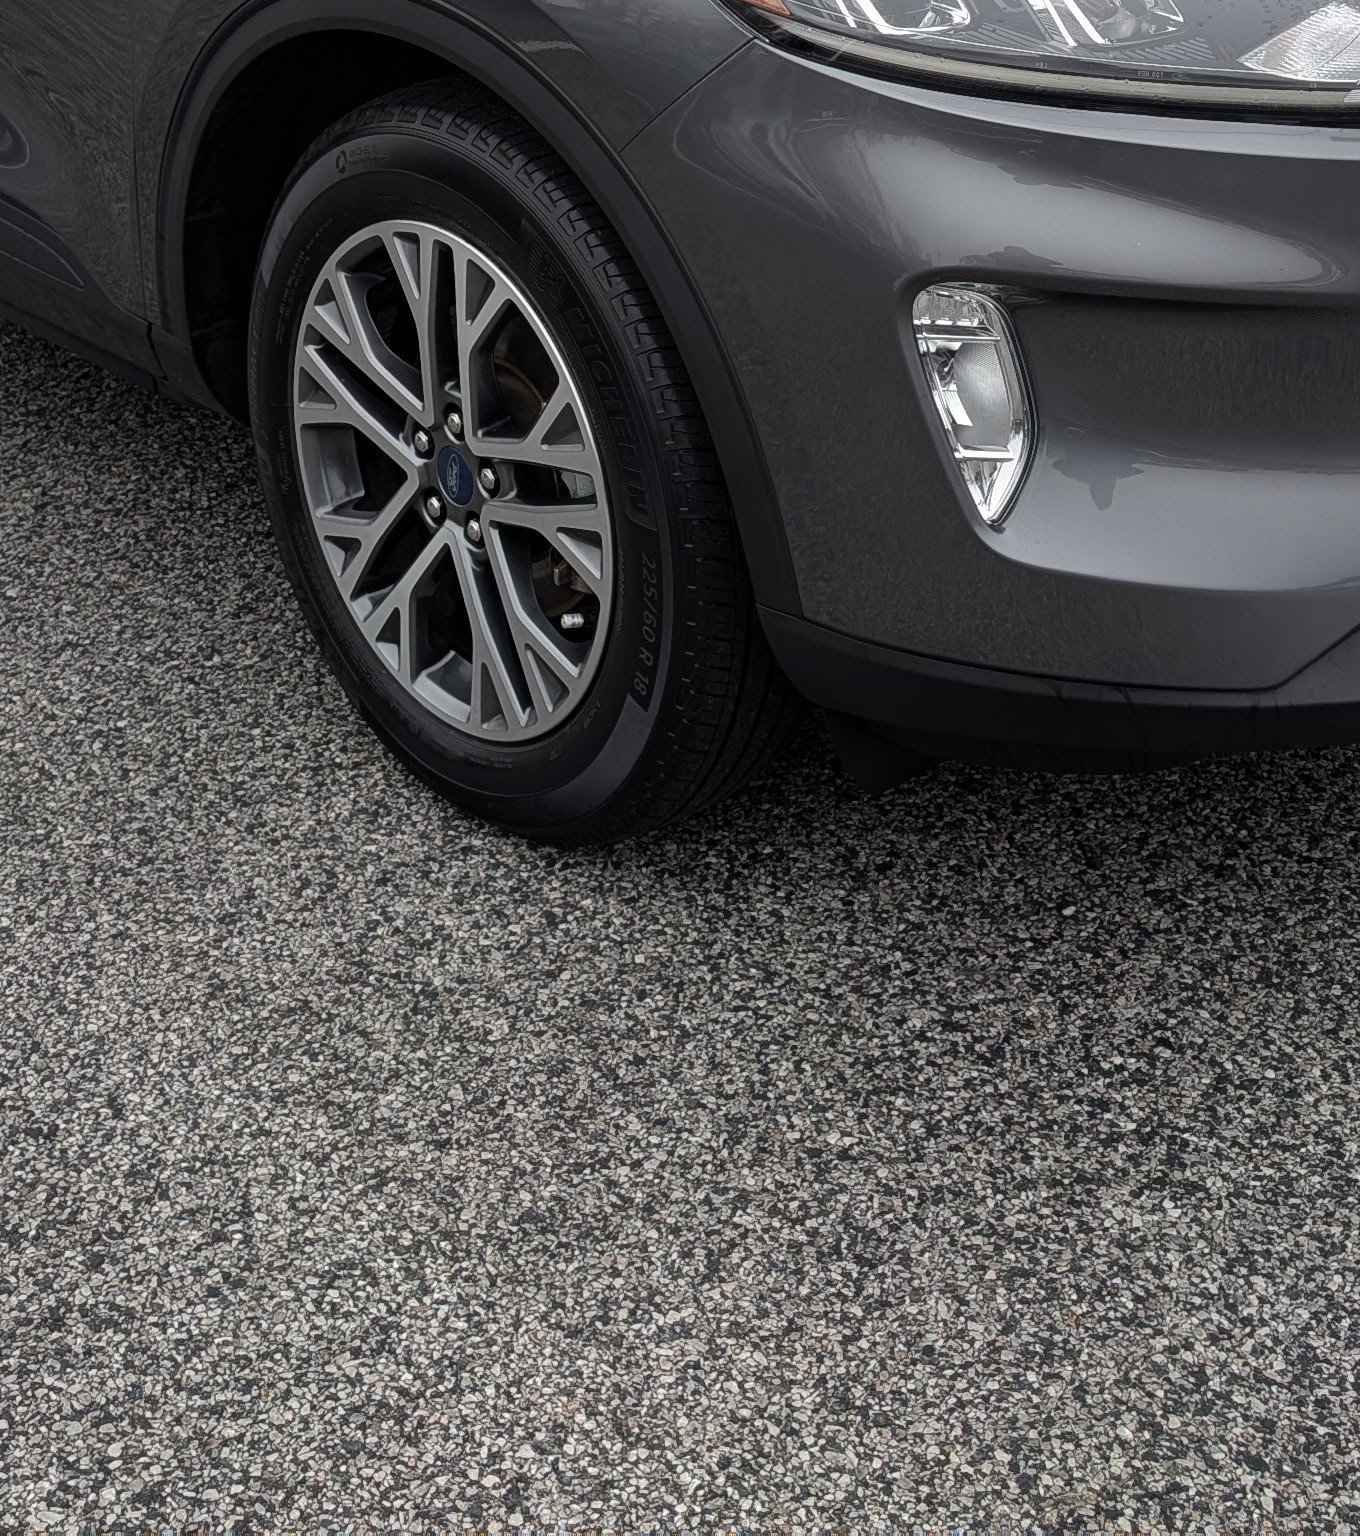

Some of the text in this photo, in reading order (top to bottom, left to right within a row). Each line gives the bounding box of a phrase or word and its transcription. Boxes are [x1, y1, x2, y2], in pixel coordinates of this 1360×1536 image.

[561, 306, 650, 517] MICHELIN
[633, 552, 658, 696] 225/60 R 18
